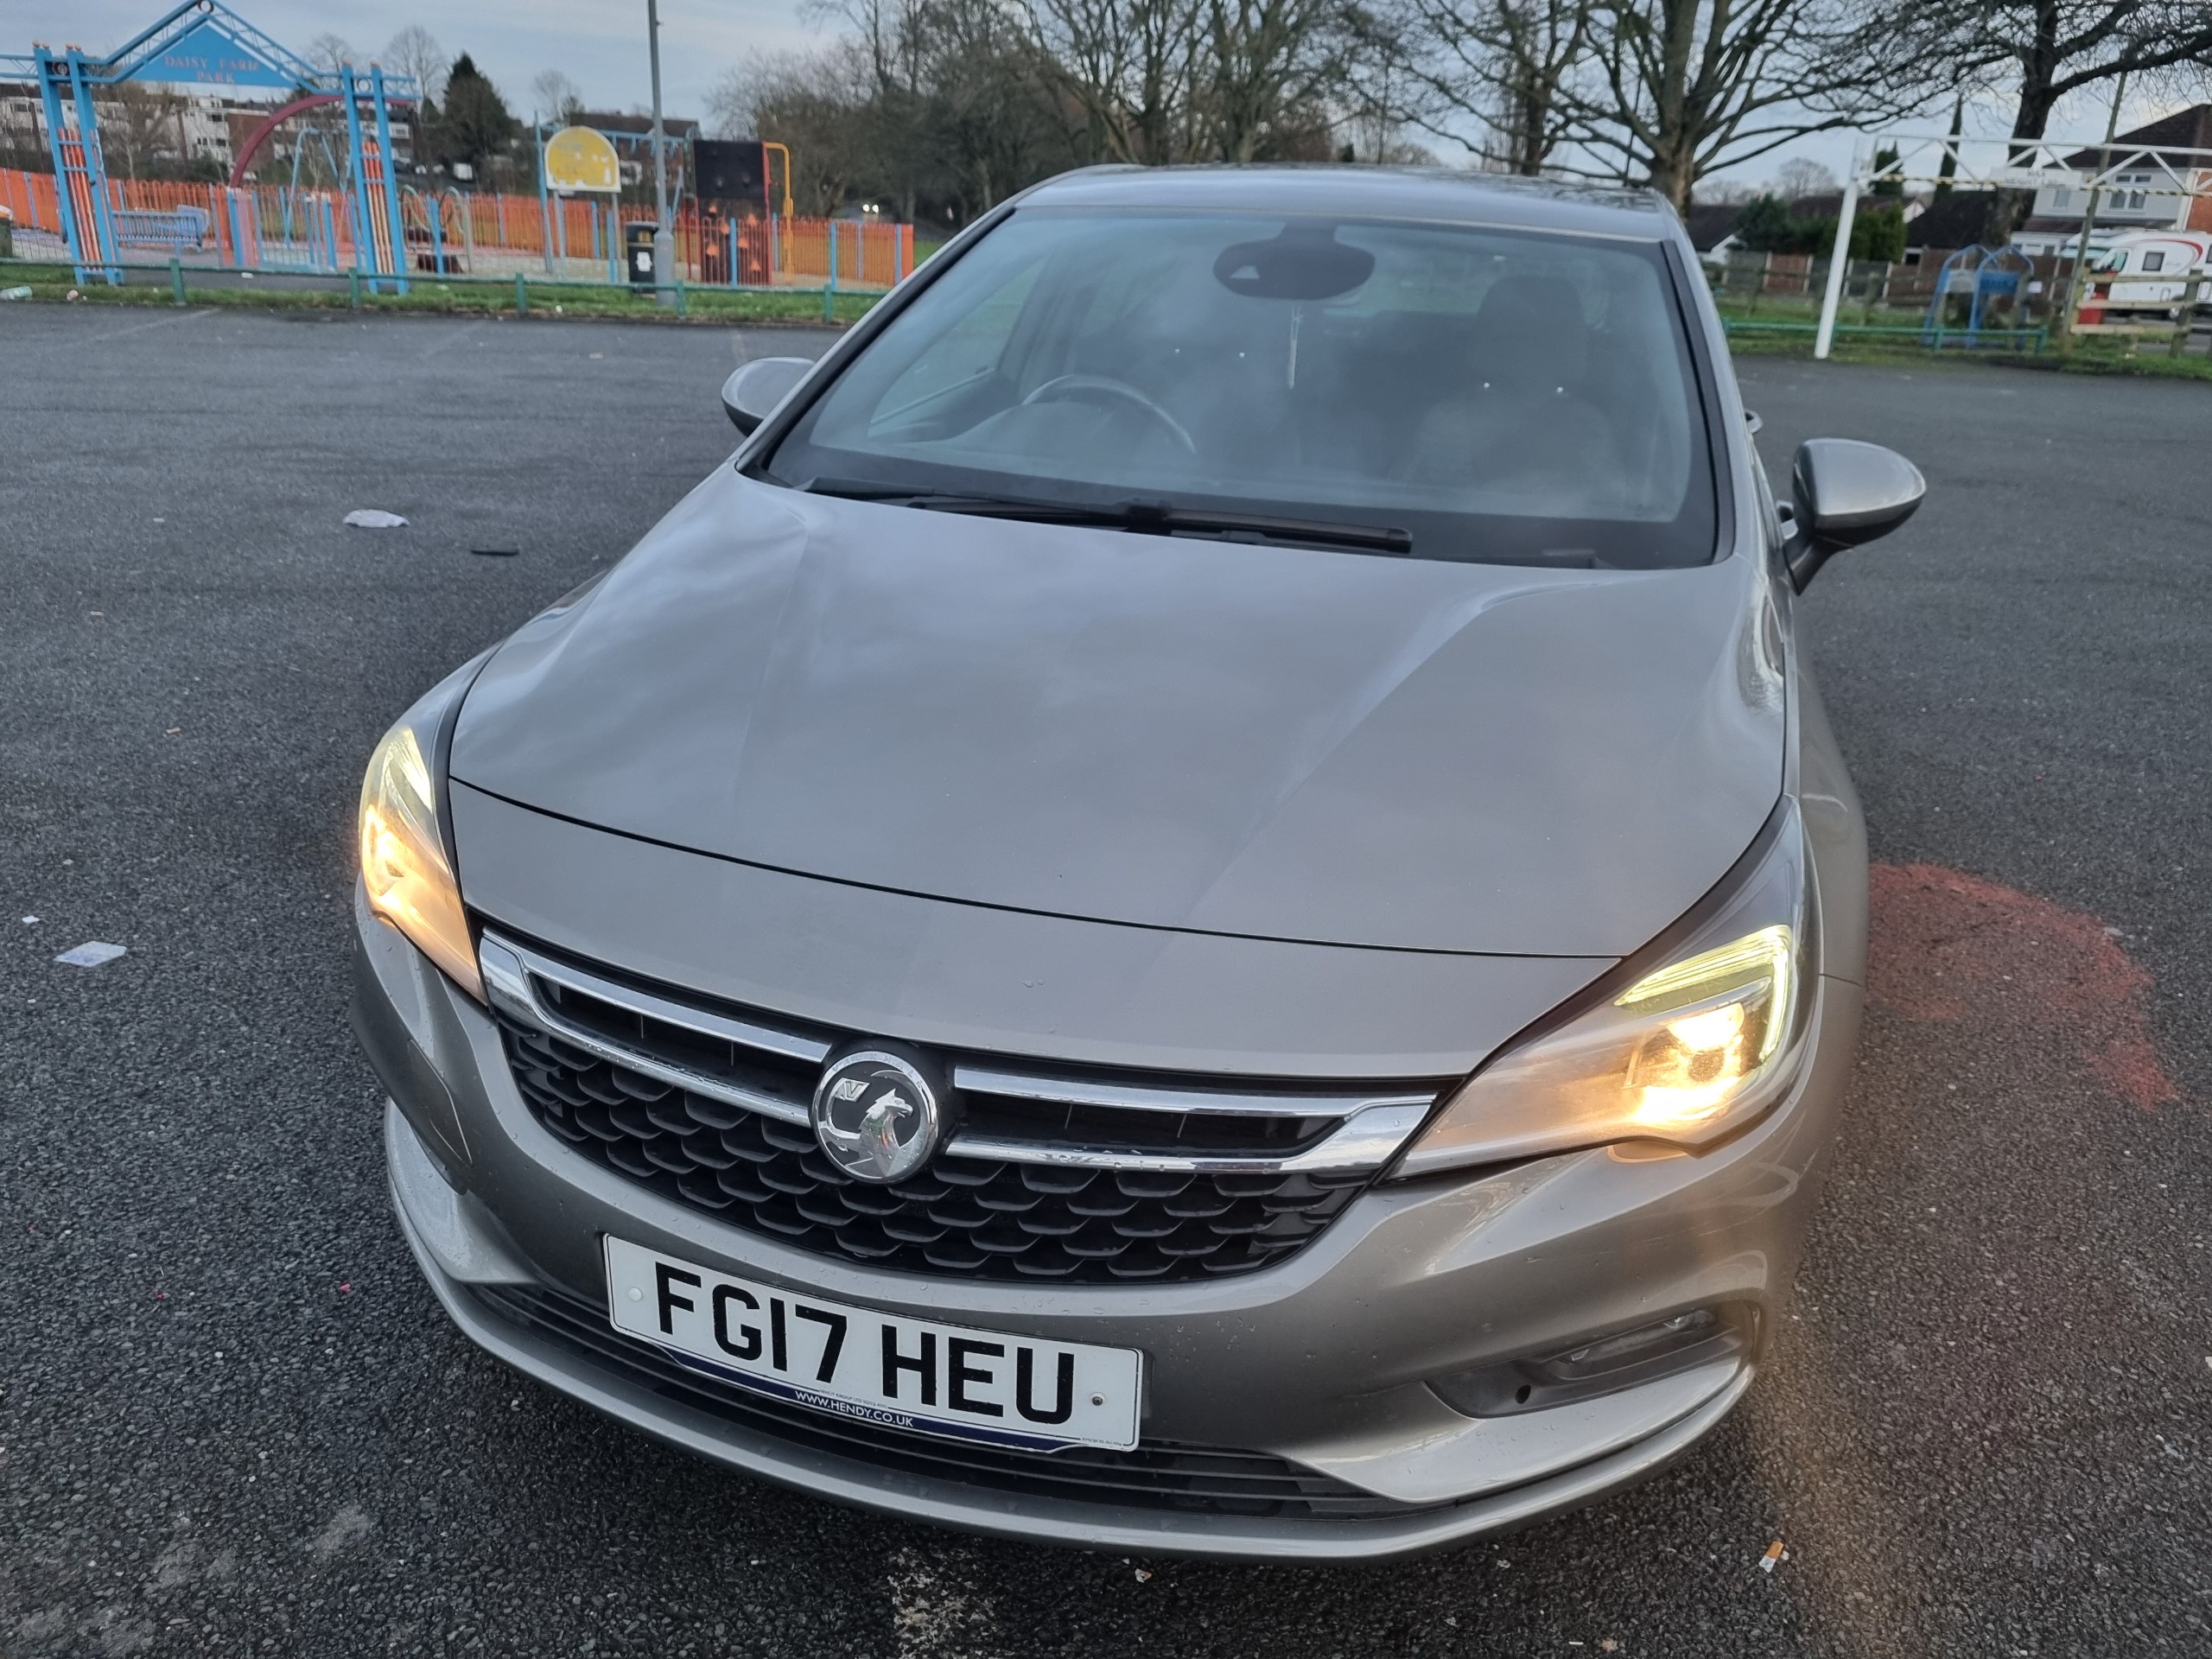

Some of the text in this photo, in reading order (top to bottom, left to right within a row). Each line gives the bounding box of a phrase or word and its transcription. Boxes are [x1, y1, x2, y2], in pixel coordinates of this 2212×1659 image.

[164, 54, 207, 68] DAISY
[196, 70, 235, 84] PARK
[654, 1261, 1075, 1425] FG17 HEU
[795, 1390, 913, 1427] WWW.HENDY.CO.UK
